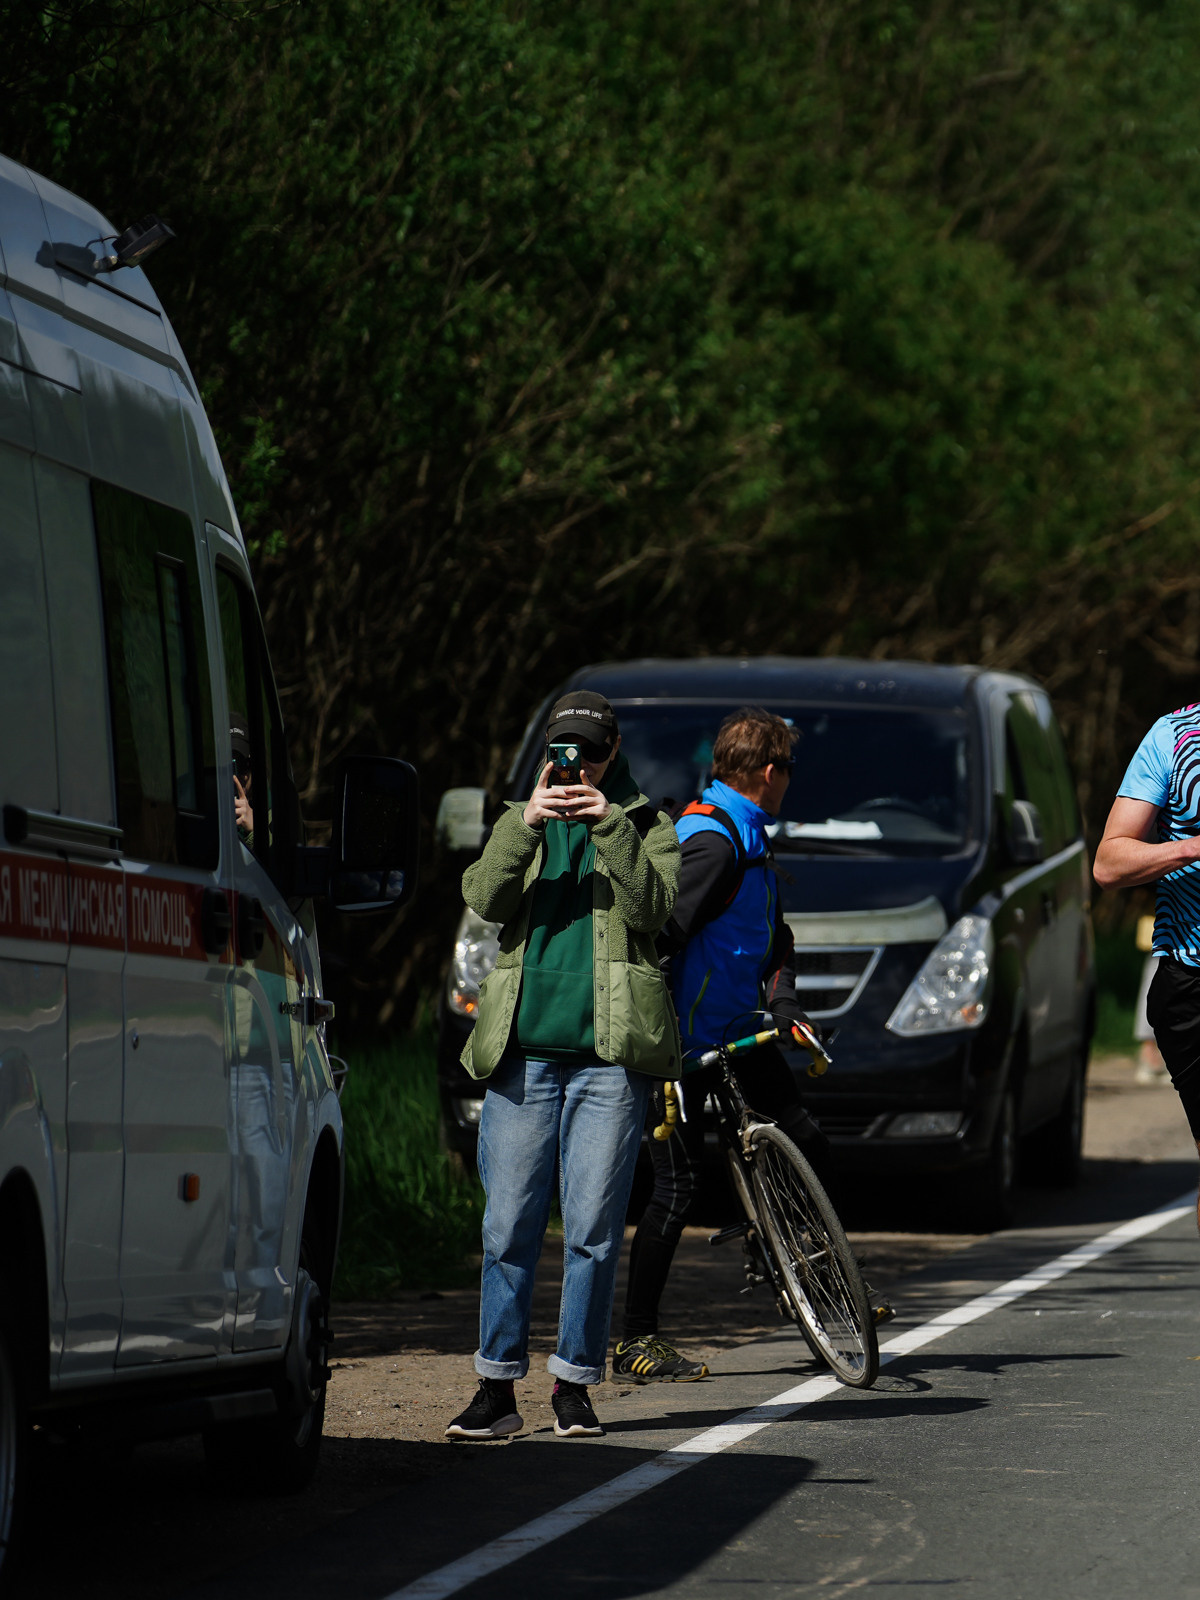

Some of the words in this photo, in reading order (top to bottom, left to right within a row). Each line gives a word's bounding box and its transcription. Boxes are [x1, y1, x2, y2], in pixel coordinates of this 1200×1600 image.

[556, 709, 575, 718] CHANGE
[591, 711, 602, 719] LIFE
[0, 865, 12, 924] Я
[18, 867, 125, 939] МЕДИЦИНСКАЯ
[131, 887, 192, 956] ПОМОЩЬ
